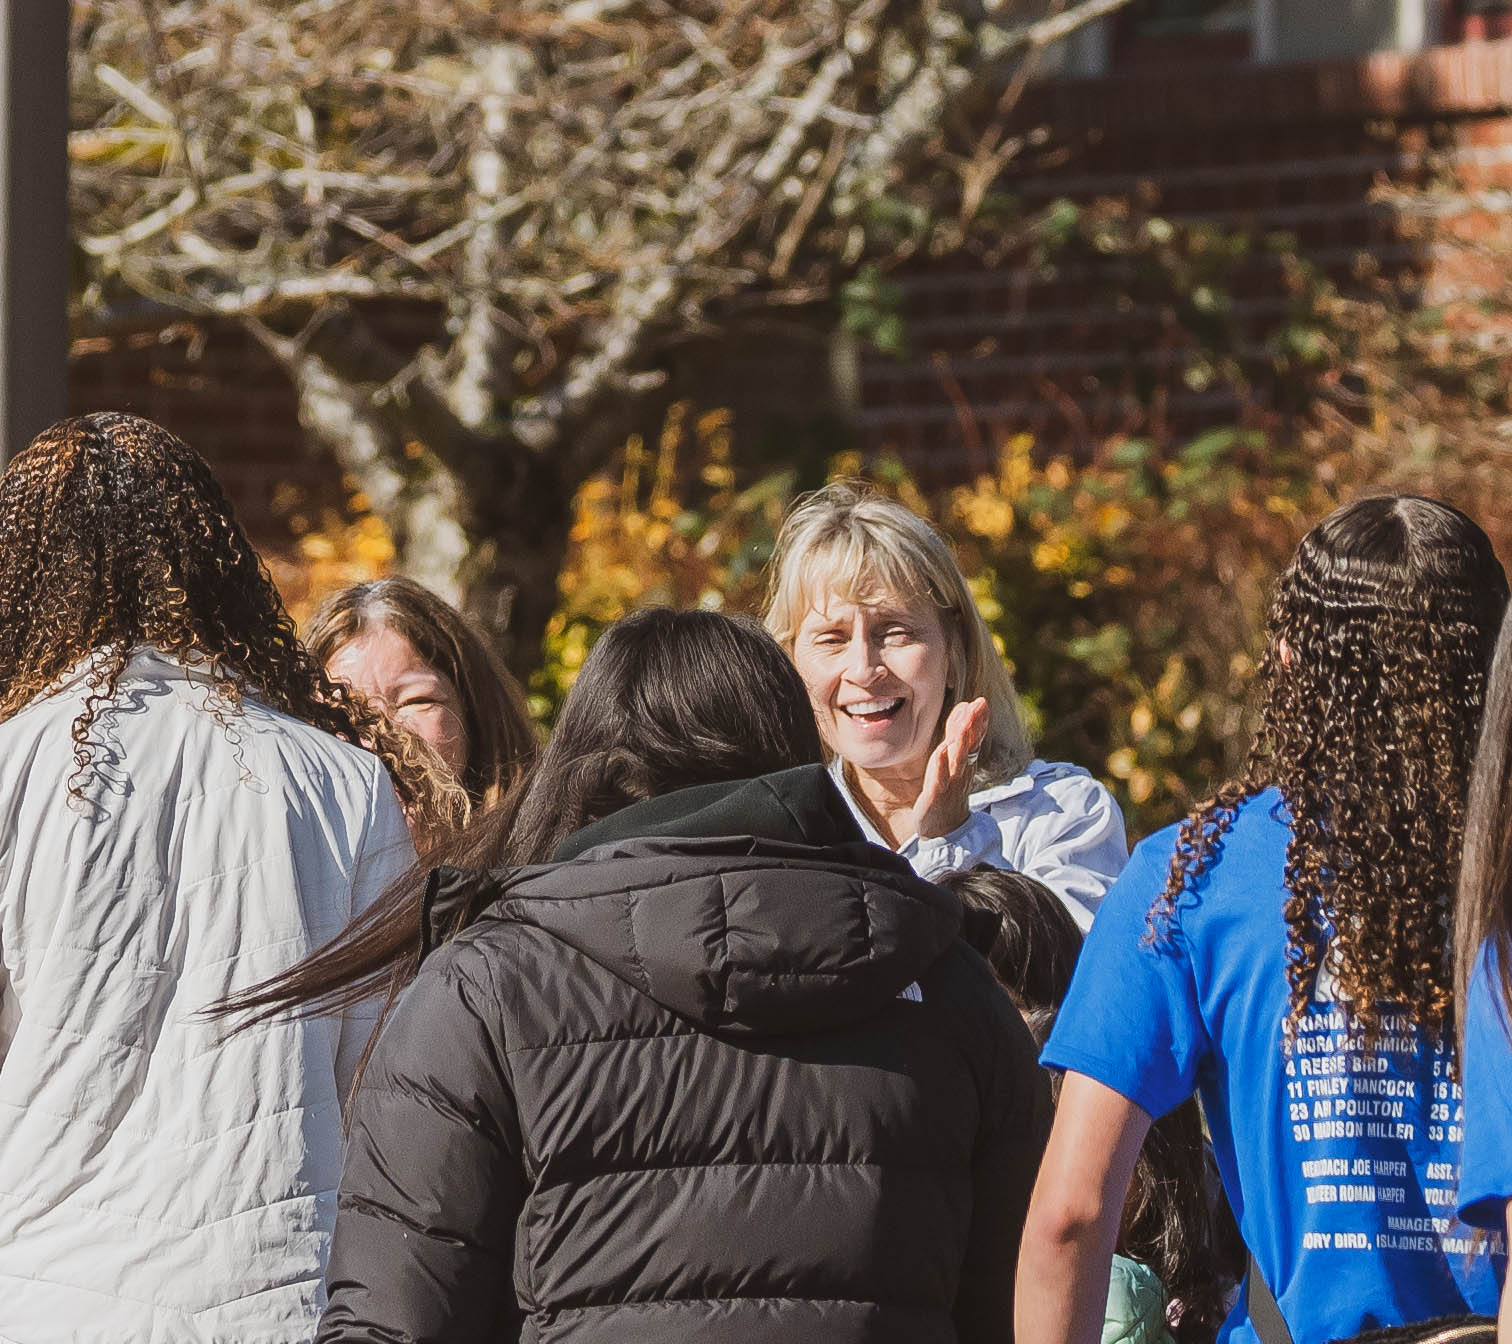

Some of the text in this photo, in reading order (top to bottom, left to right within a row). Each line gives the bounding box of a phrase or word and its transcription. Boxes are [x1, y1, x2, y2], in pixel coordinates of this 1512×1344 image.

[1286, 1056, 1389, 1077] 4 REESE BIRD
[1288, 1077, 1416, 1099] 11 FINLEY HANCOCK
[1335, 1099, 1404, 1119] POULTON
[1293, 1123, 1311, 1142] 30
[1367, 1123, 1415, 1140] MILLER
[1351, 1158, 1371, 1176] JOE
[1373, 1159, 1407, 1177] HARPER
[1340, 1184, 1376, 1203] ROMAN
[1377, 1186, 1406, 1204] HARPER
[1387, 1215, 1450, 1233] MANAGERS
[1334, 1232, 1373, 1251] BIRD,
